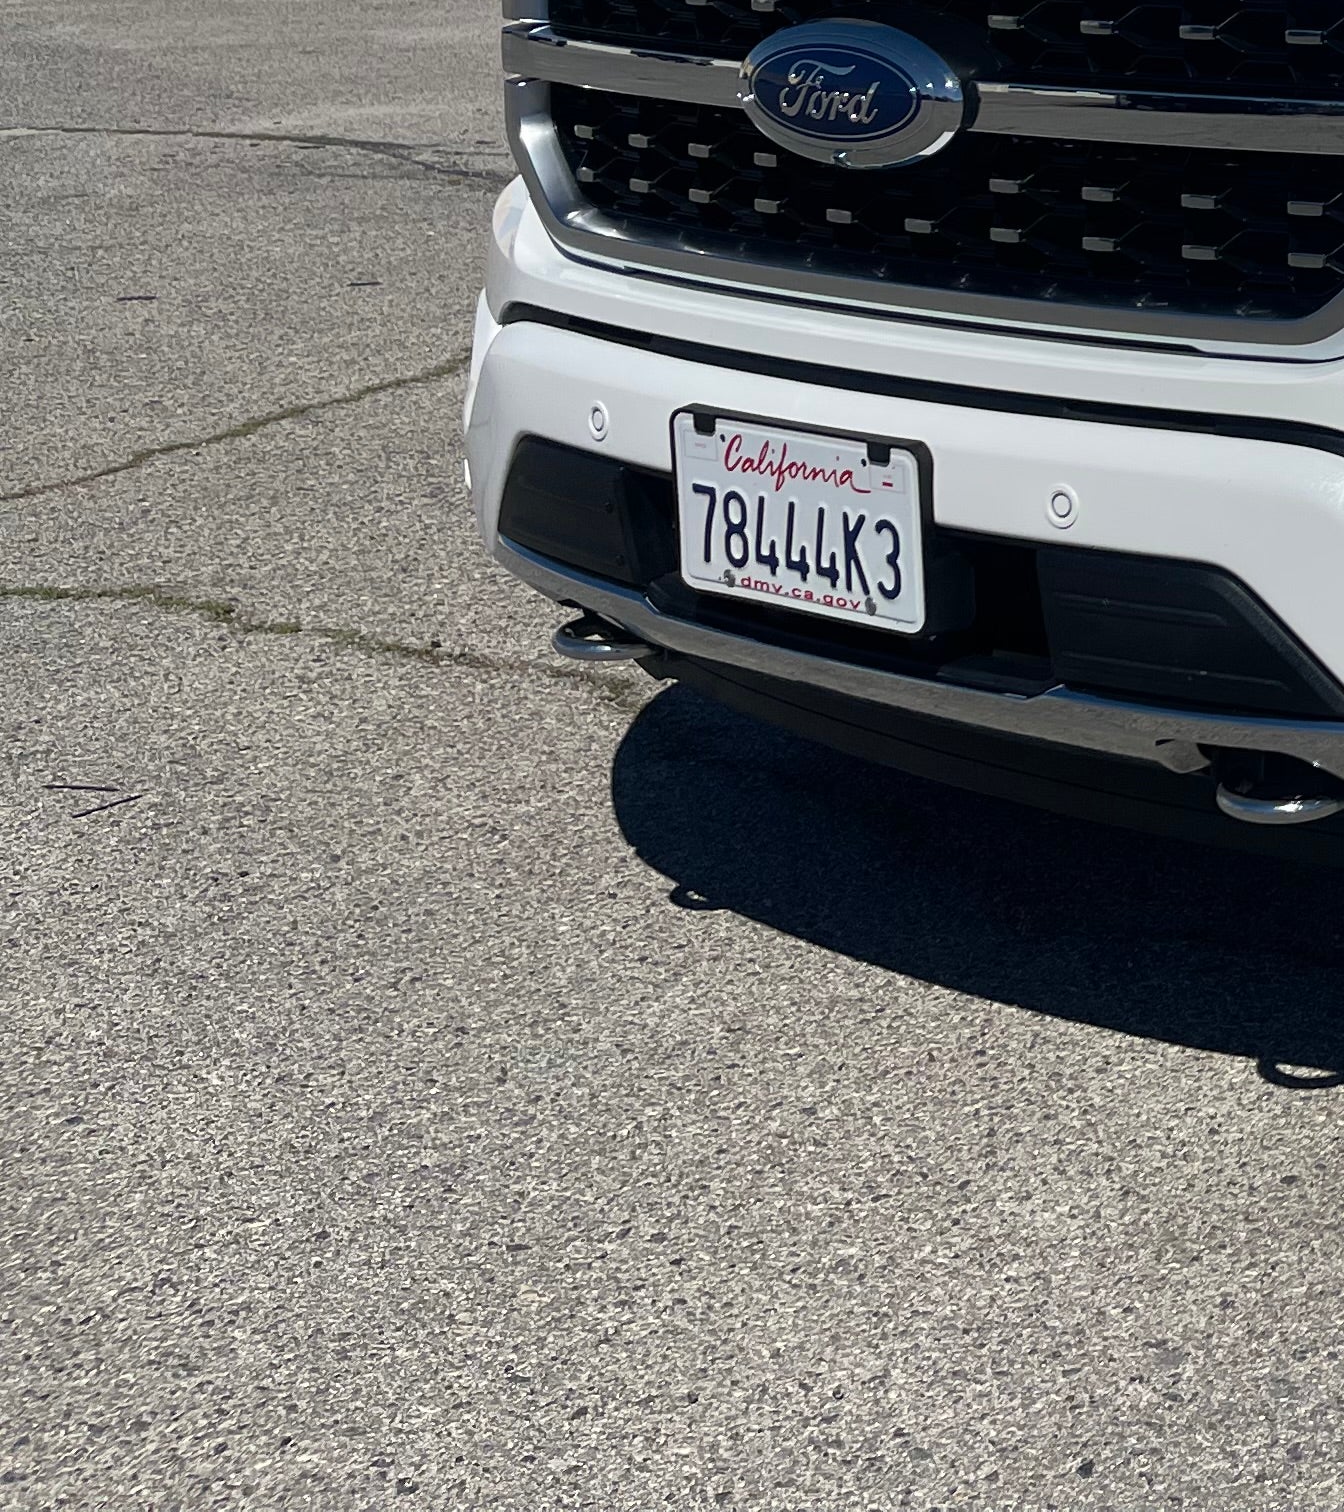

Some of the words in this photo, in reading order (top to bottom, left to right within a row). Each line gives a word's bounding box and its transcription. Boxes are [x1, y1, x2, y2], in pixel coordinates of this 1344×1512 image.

[779, 59, 881, 125] Ford
[724, 434, 872, 494] California
[692, 482, 902, 600] 78444K3
[740, 575, 861, 611] dmv.ca.gov
